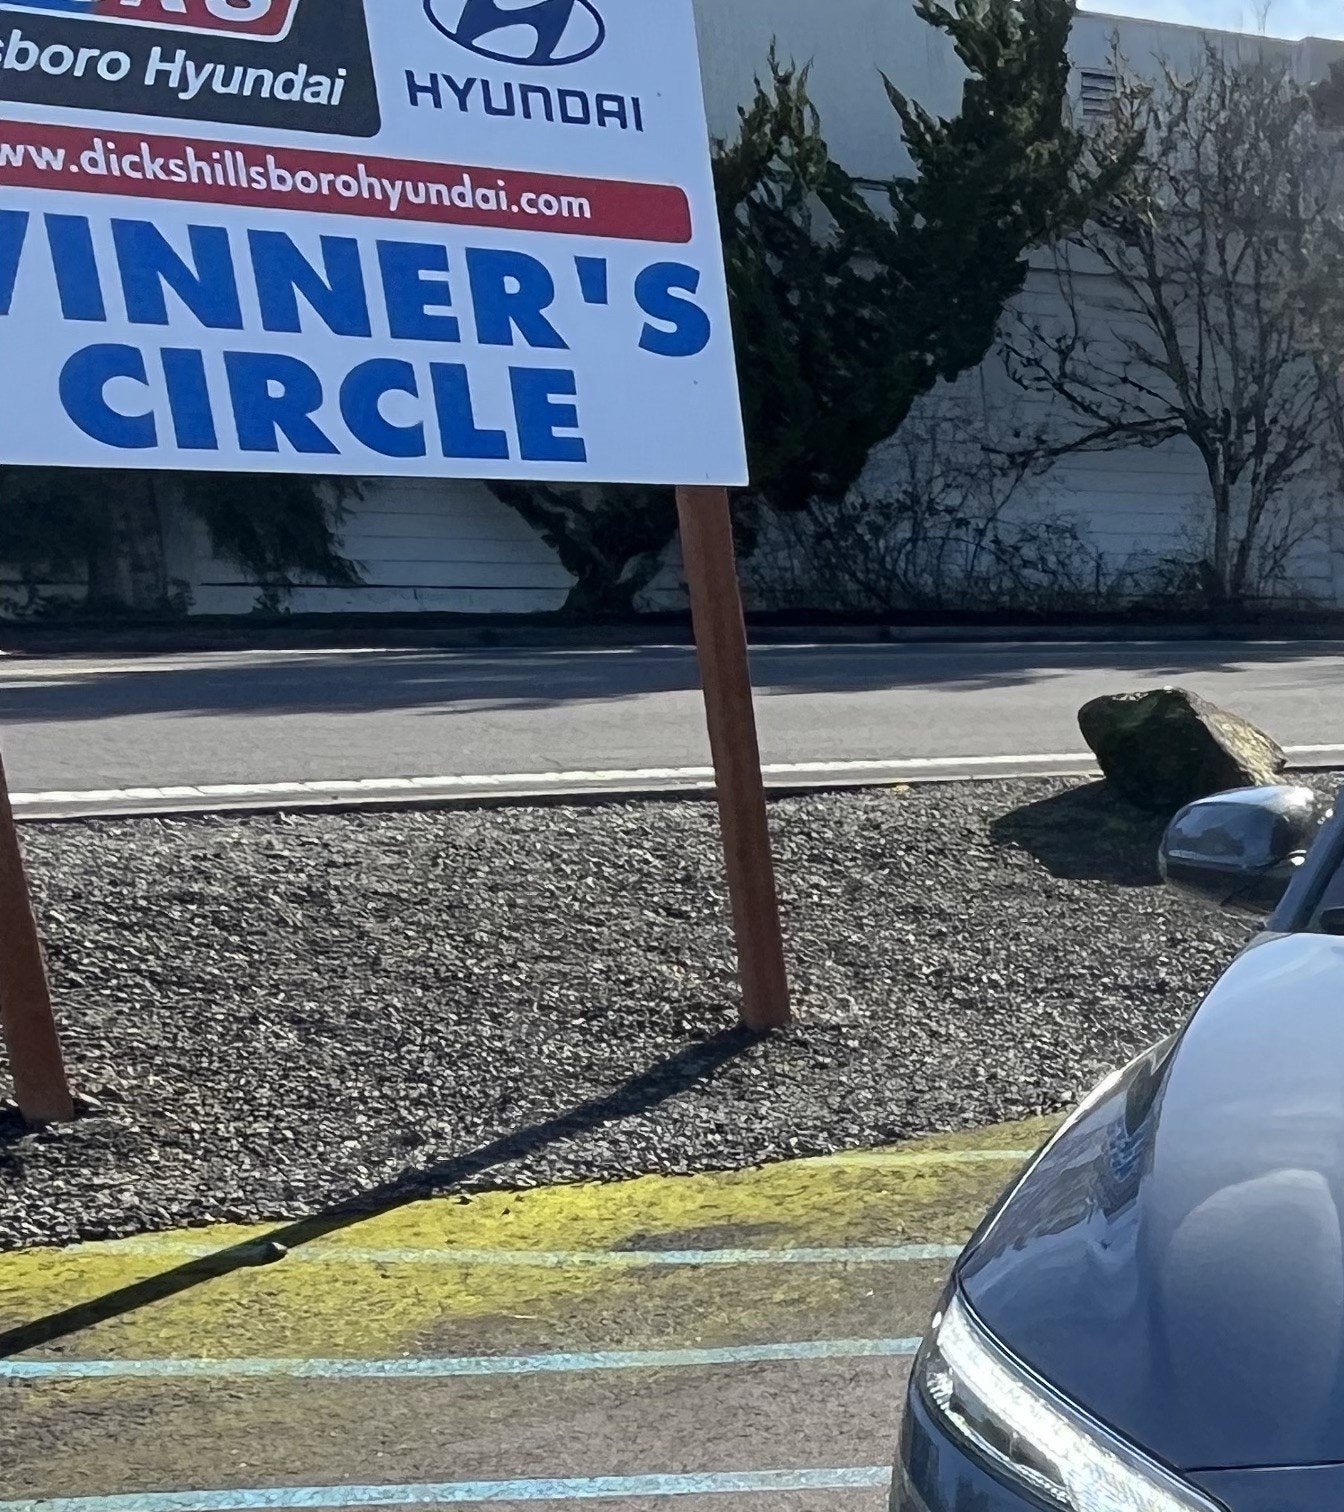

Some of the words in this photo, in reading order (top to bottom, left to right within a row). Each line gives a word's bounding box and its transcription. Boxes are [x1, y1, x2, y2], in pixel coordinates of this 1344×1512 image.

[0, 29, 131, 81] boro
[144, 46, 347, 106] Hyundai
[405, 70, 644, 132] HYUNDAI
[0, 210, 711, 358] INNER'S
[59, 343, 588, 463] CIRCLE
